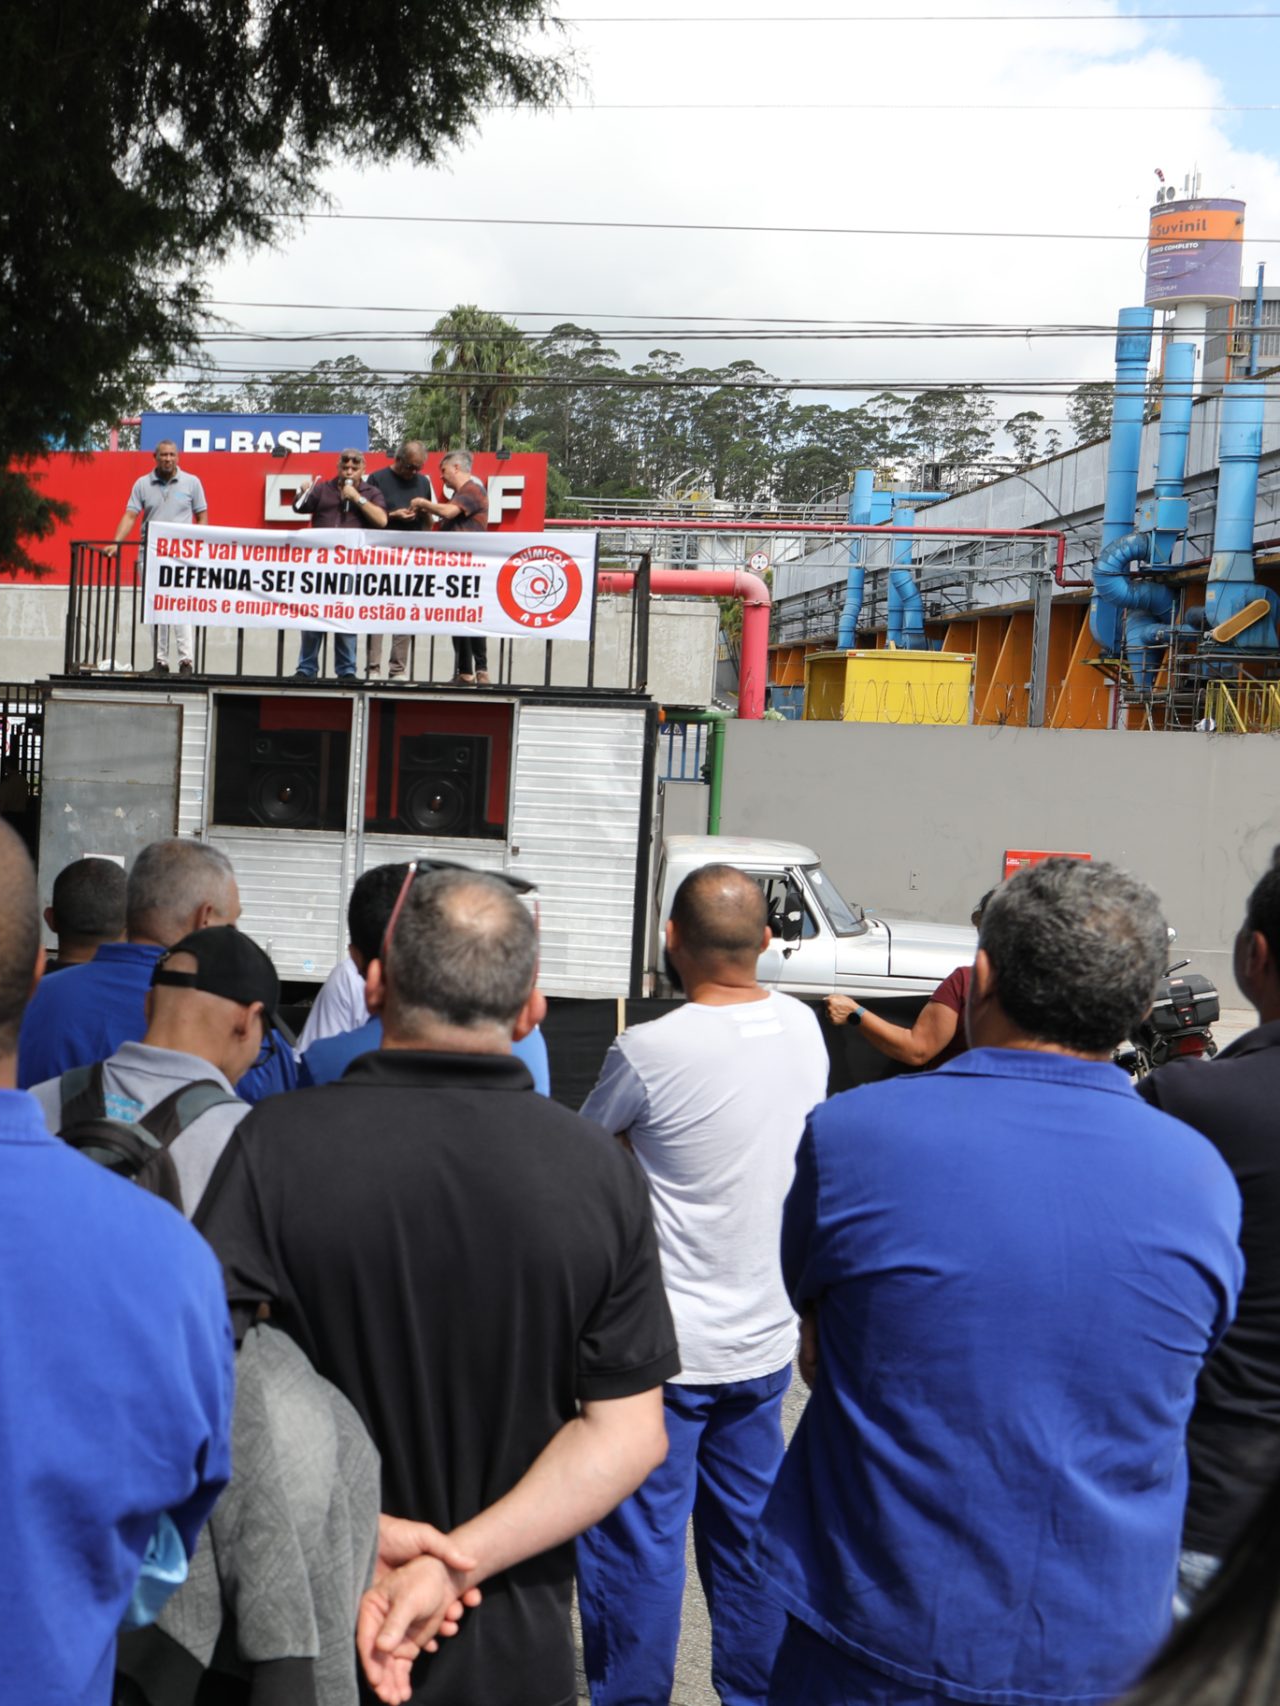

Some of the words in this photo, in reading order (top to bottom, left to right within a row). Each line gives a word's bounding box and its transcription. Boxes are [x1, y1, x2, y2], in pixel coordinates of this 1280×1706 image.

[1155, 219, 1207, 236] Suvinil
[231, 430, 322, 453] BASF
[156, 538, 204, 558] BASF
[208, 541, 238, 561] vai
[242, 544, 312, 564] vender
[316, 547, 329, 564] a
[334, 544, 487, 568] Suvinil/Glasu...
[511, 547, 569, 568] QUÍMICOS
[158, 565, 295, 593] DEFENDA-SE!
[300, 571, 481, 599] SINDICALIZE-SE!
[153, 594, 217, 613] Direitos
[221, 600, 231, 614] e
[235, 599, 319, 618] empregos
[323, 601, 354, 619] não
[359, 603, 406, 622] estão
[410, 604, 420, 621] à
[424, 606, 484, 623] venda!
